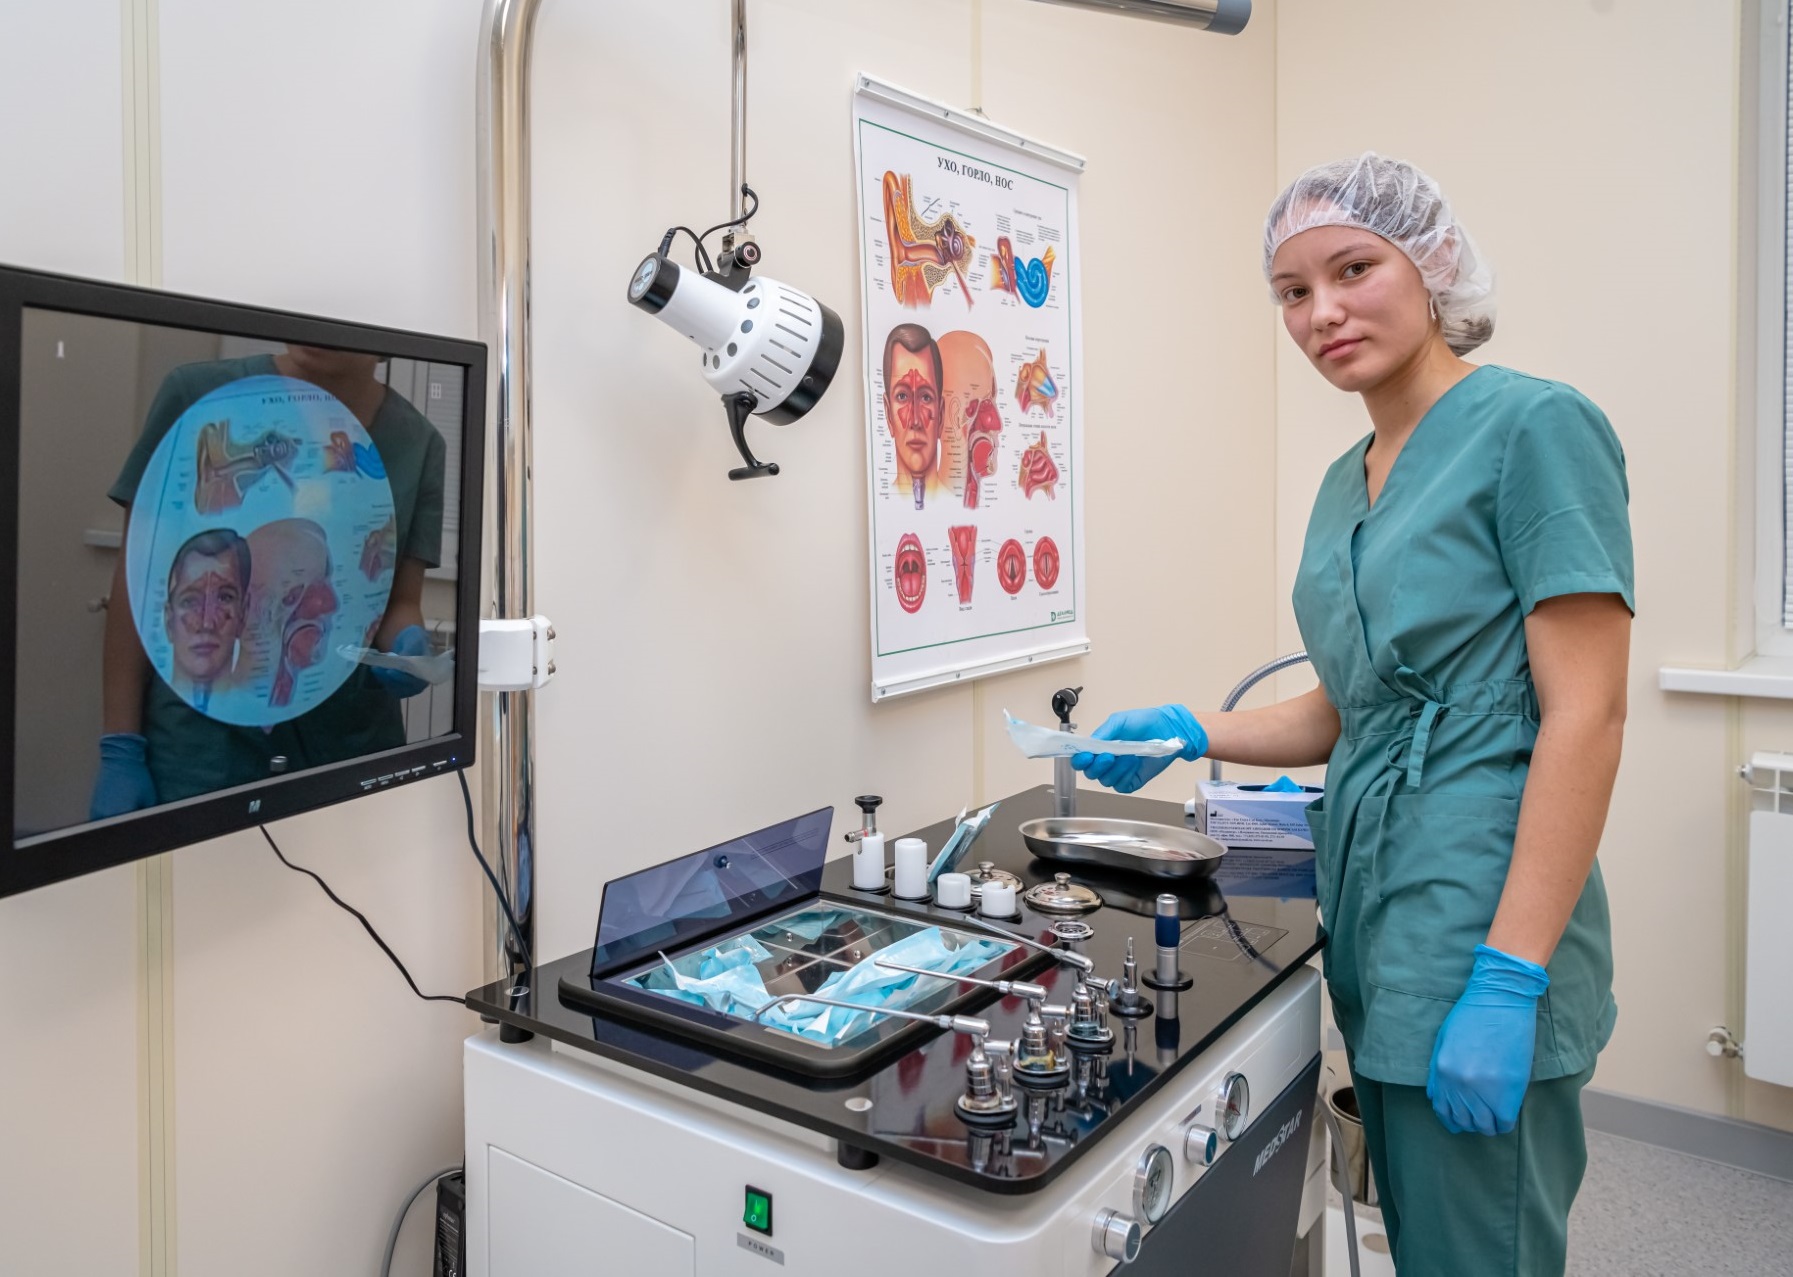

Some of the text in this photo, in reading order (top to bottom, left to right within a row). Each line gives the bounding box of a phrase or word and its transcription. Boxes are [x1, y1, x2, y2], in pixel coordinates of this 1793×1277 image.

[937, 156, 1014, 190] УХО, ГОРЛО, НОС
[748, 1240, 774, 1256] POWER
